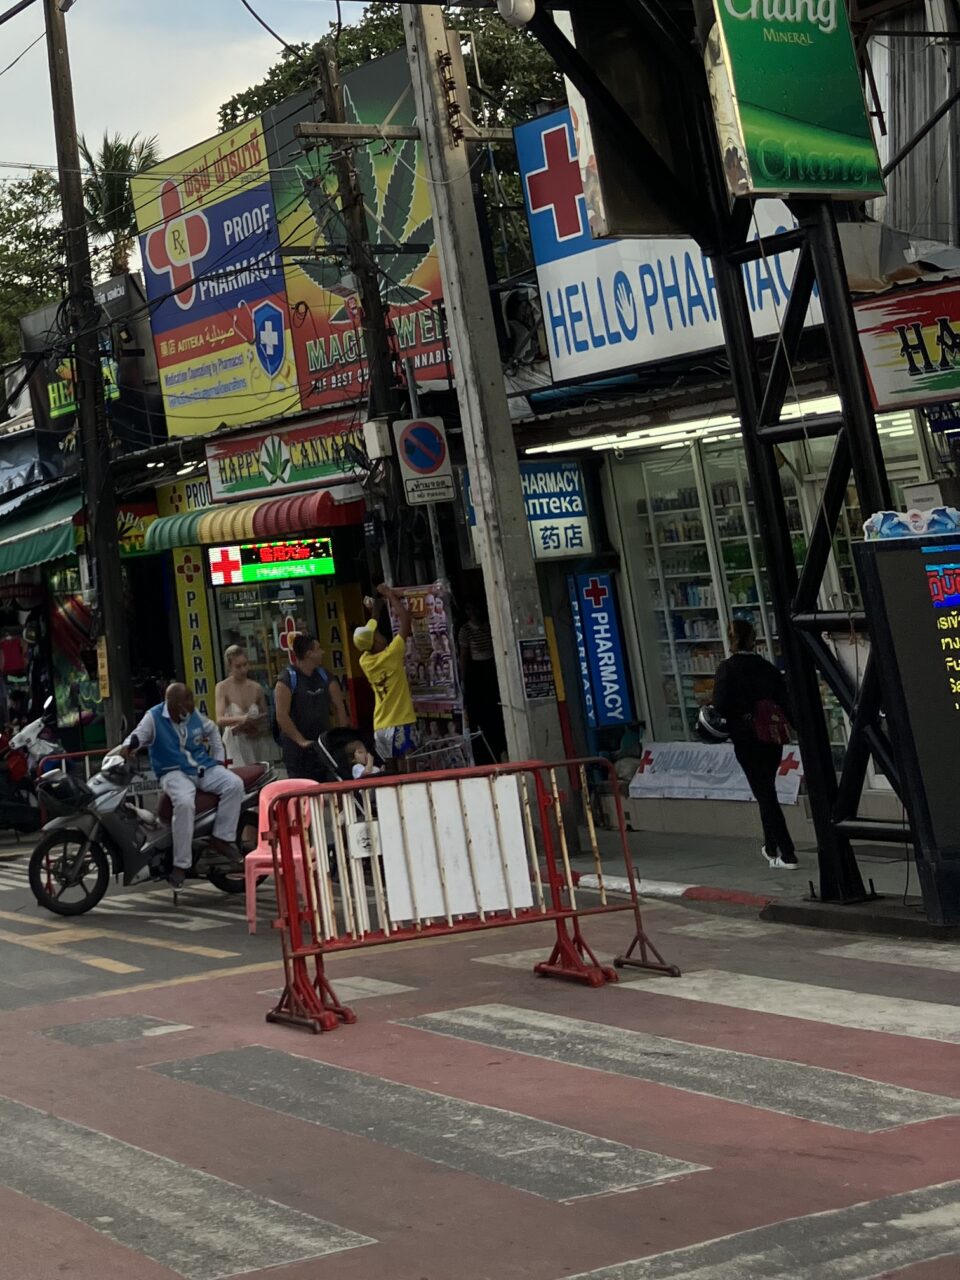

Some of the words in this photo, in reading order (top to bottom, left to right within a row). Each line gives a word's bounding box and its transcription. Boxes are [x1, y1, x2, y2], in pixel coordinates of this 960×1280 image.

[223, 203, 271, 246] PROOF
[199, 251, 278, 301] PHARMACY
[545, 270, 638, 359] HELLO
[305, 326, 369, 372] MAGI
[218, 443, 263, 485] HAPPY
[413, 479, 446, 490] ห้ามจอด
[519, 469, 580, 496] HARMACY
[539, 523, 584, 551] 药店
[571, 600, 596, 721] PHARMACY
[591, 611, 625, 720] PHARMACY
